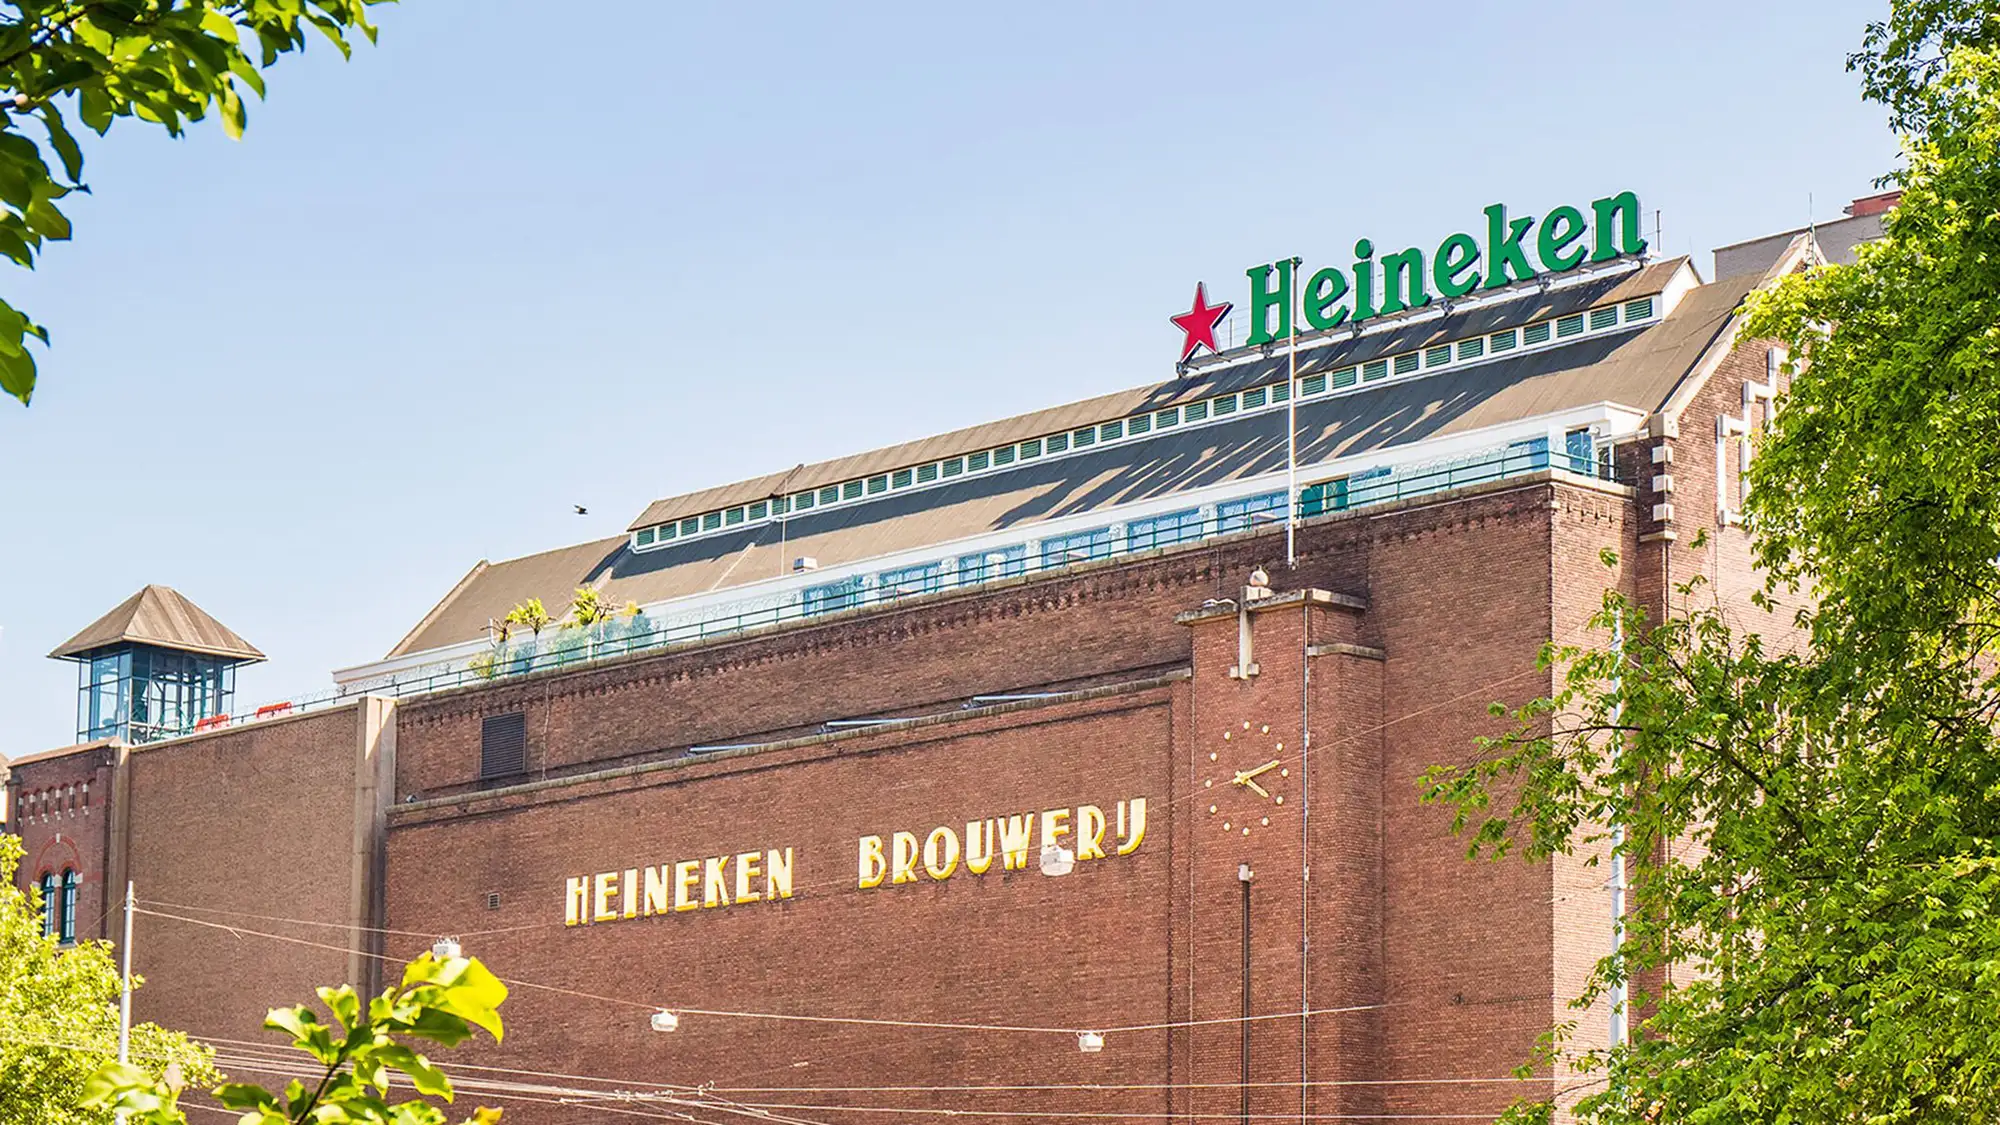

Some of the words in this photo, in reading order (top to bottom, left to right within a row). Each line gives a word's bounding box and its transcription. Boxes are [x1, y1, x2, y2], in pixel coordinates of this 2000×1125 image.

[1247, 191, 1648, 346] Heineken
[564, 846, 794, 926] HEINEKEN
[857, 797, 1148, 889] BROUWERIJ
